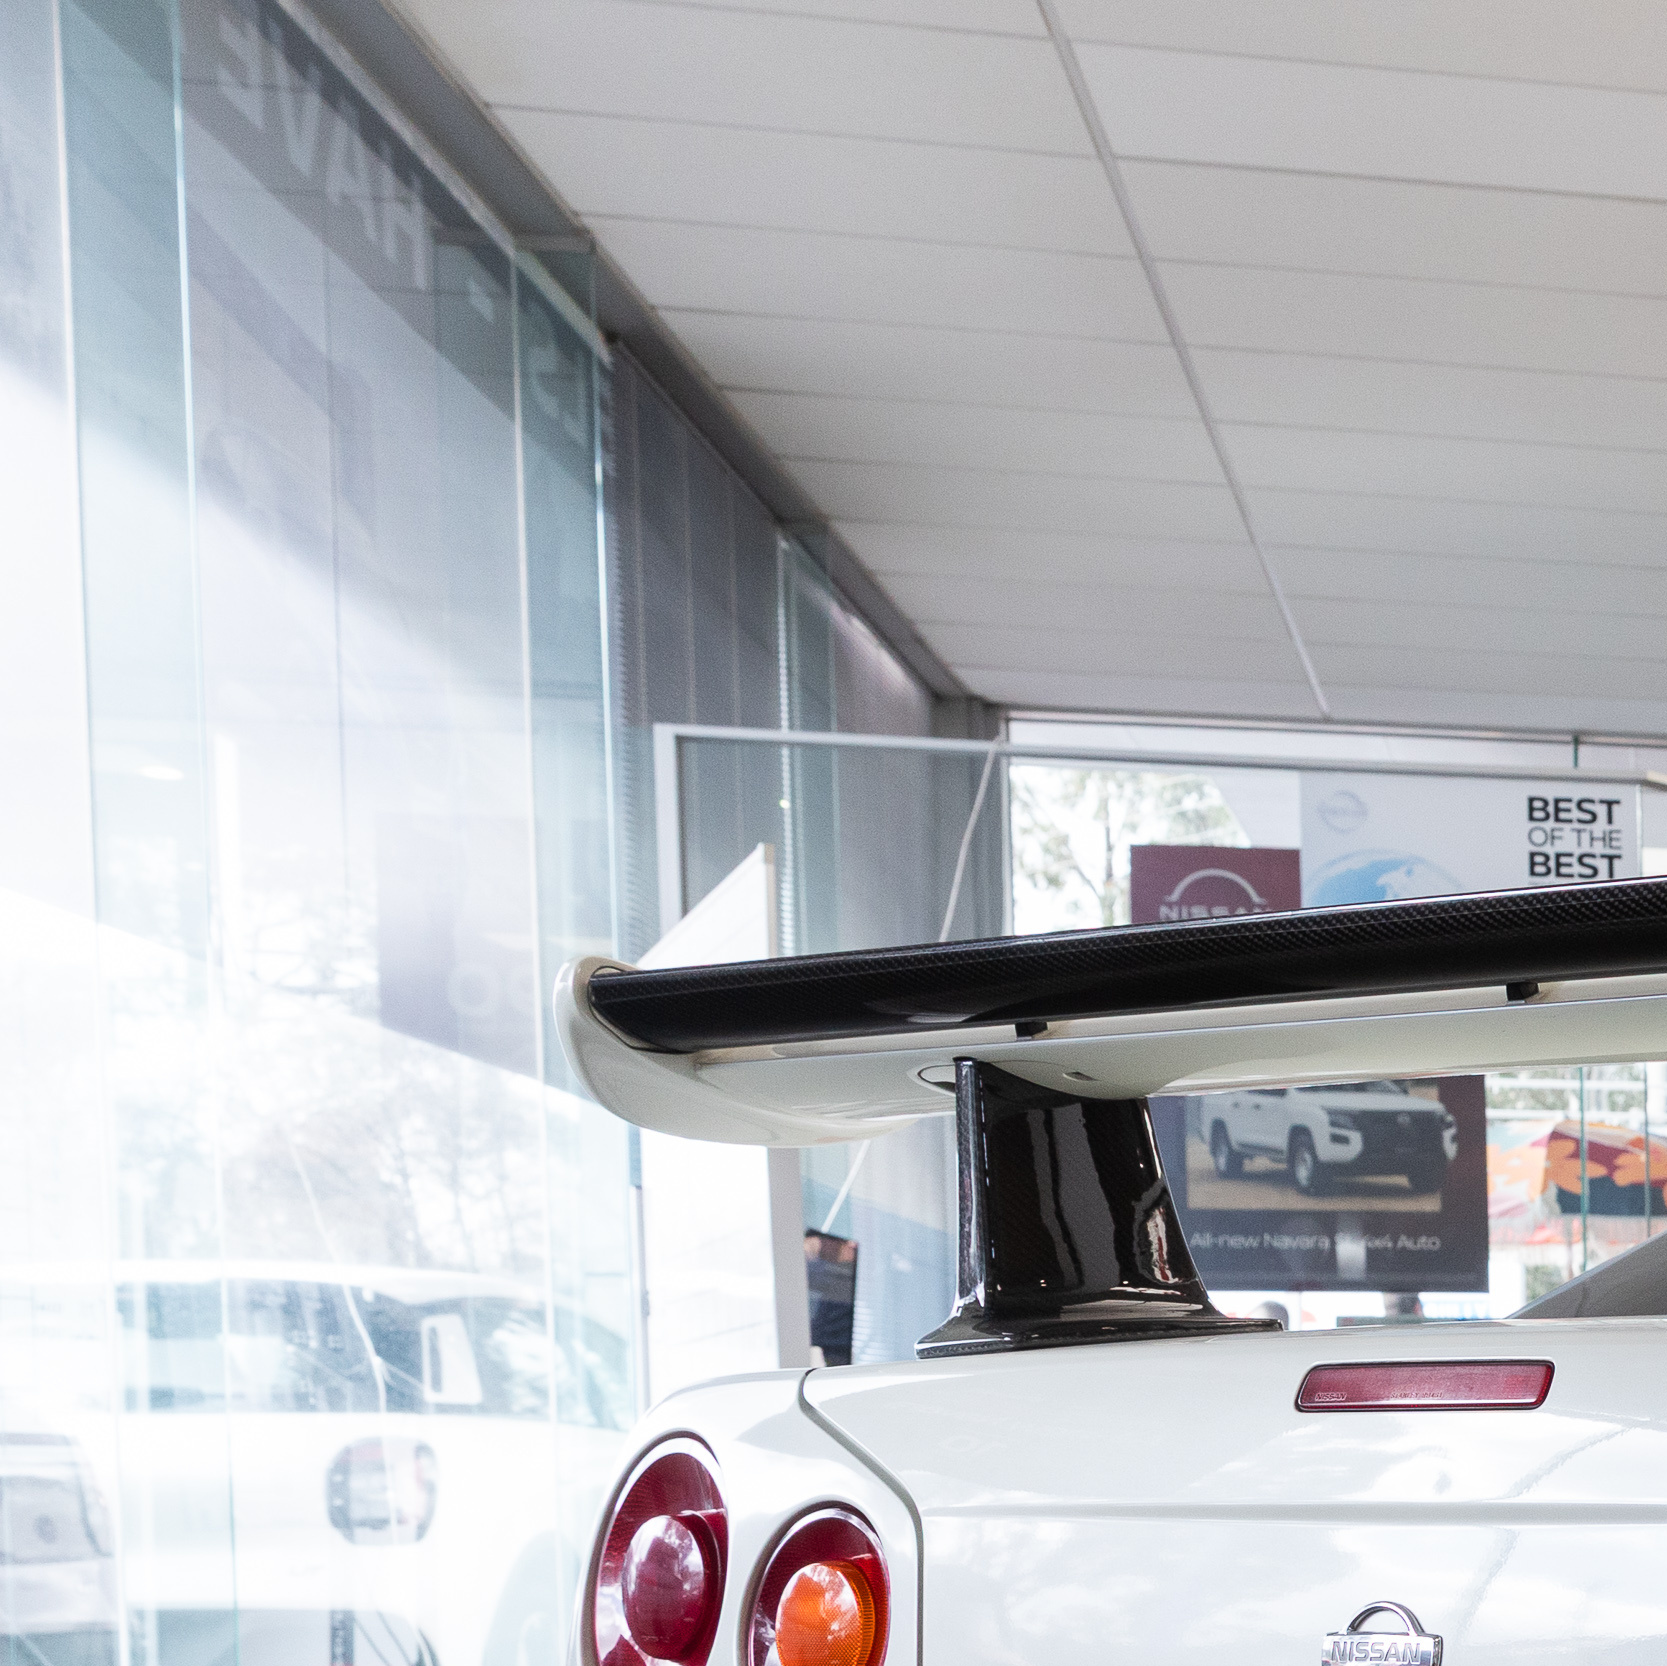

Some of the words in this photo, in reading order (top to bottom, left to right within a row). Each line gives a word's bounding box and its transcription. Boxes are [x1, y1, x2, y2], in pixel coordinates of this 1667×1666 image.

[1527, 795, 1621, 825] BEST
[1528, 826, 1564, 847] OF
[1571, 827, 1622, 850] THE
[1528, 851, 1622, 879] BEST
[1190, 1231, 1259, 1249] All-new
[1396, 1233, 1442, 1251] Auto
[1331, 1640, 1421, 1665] NISSAN
